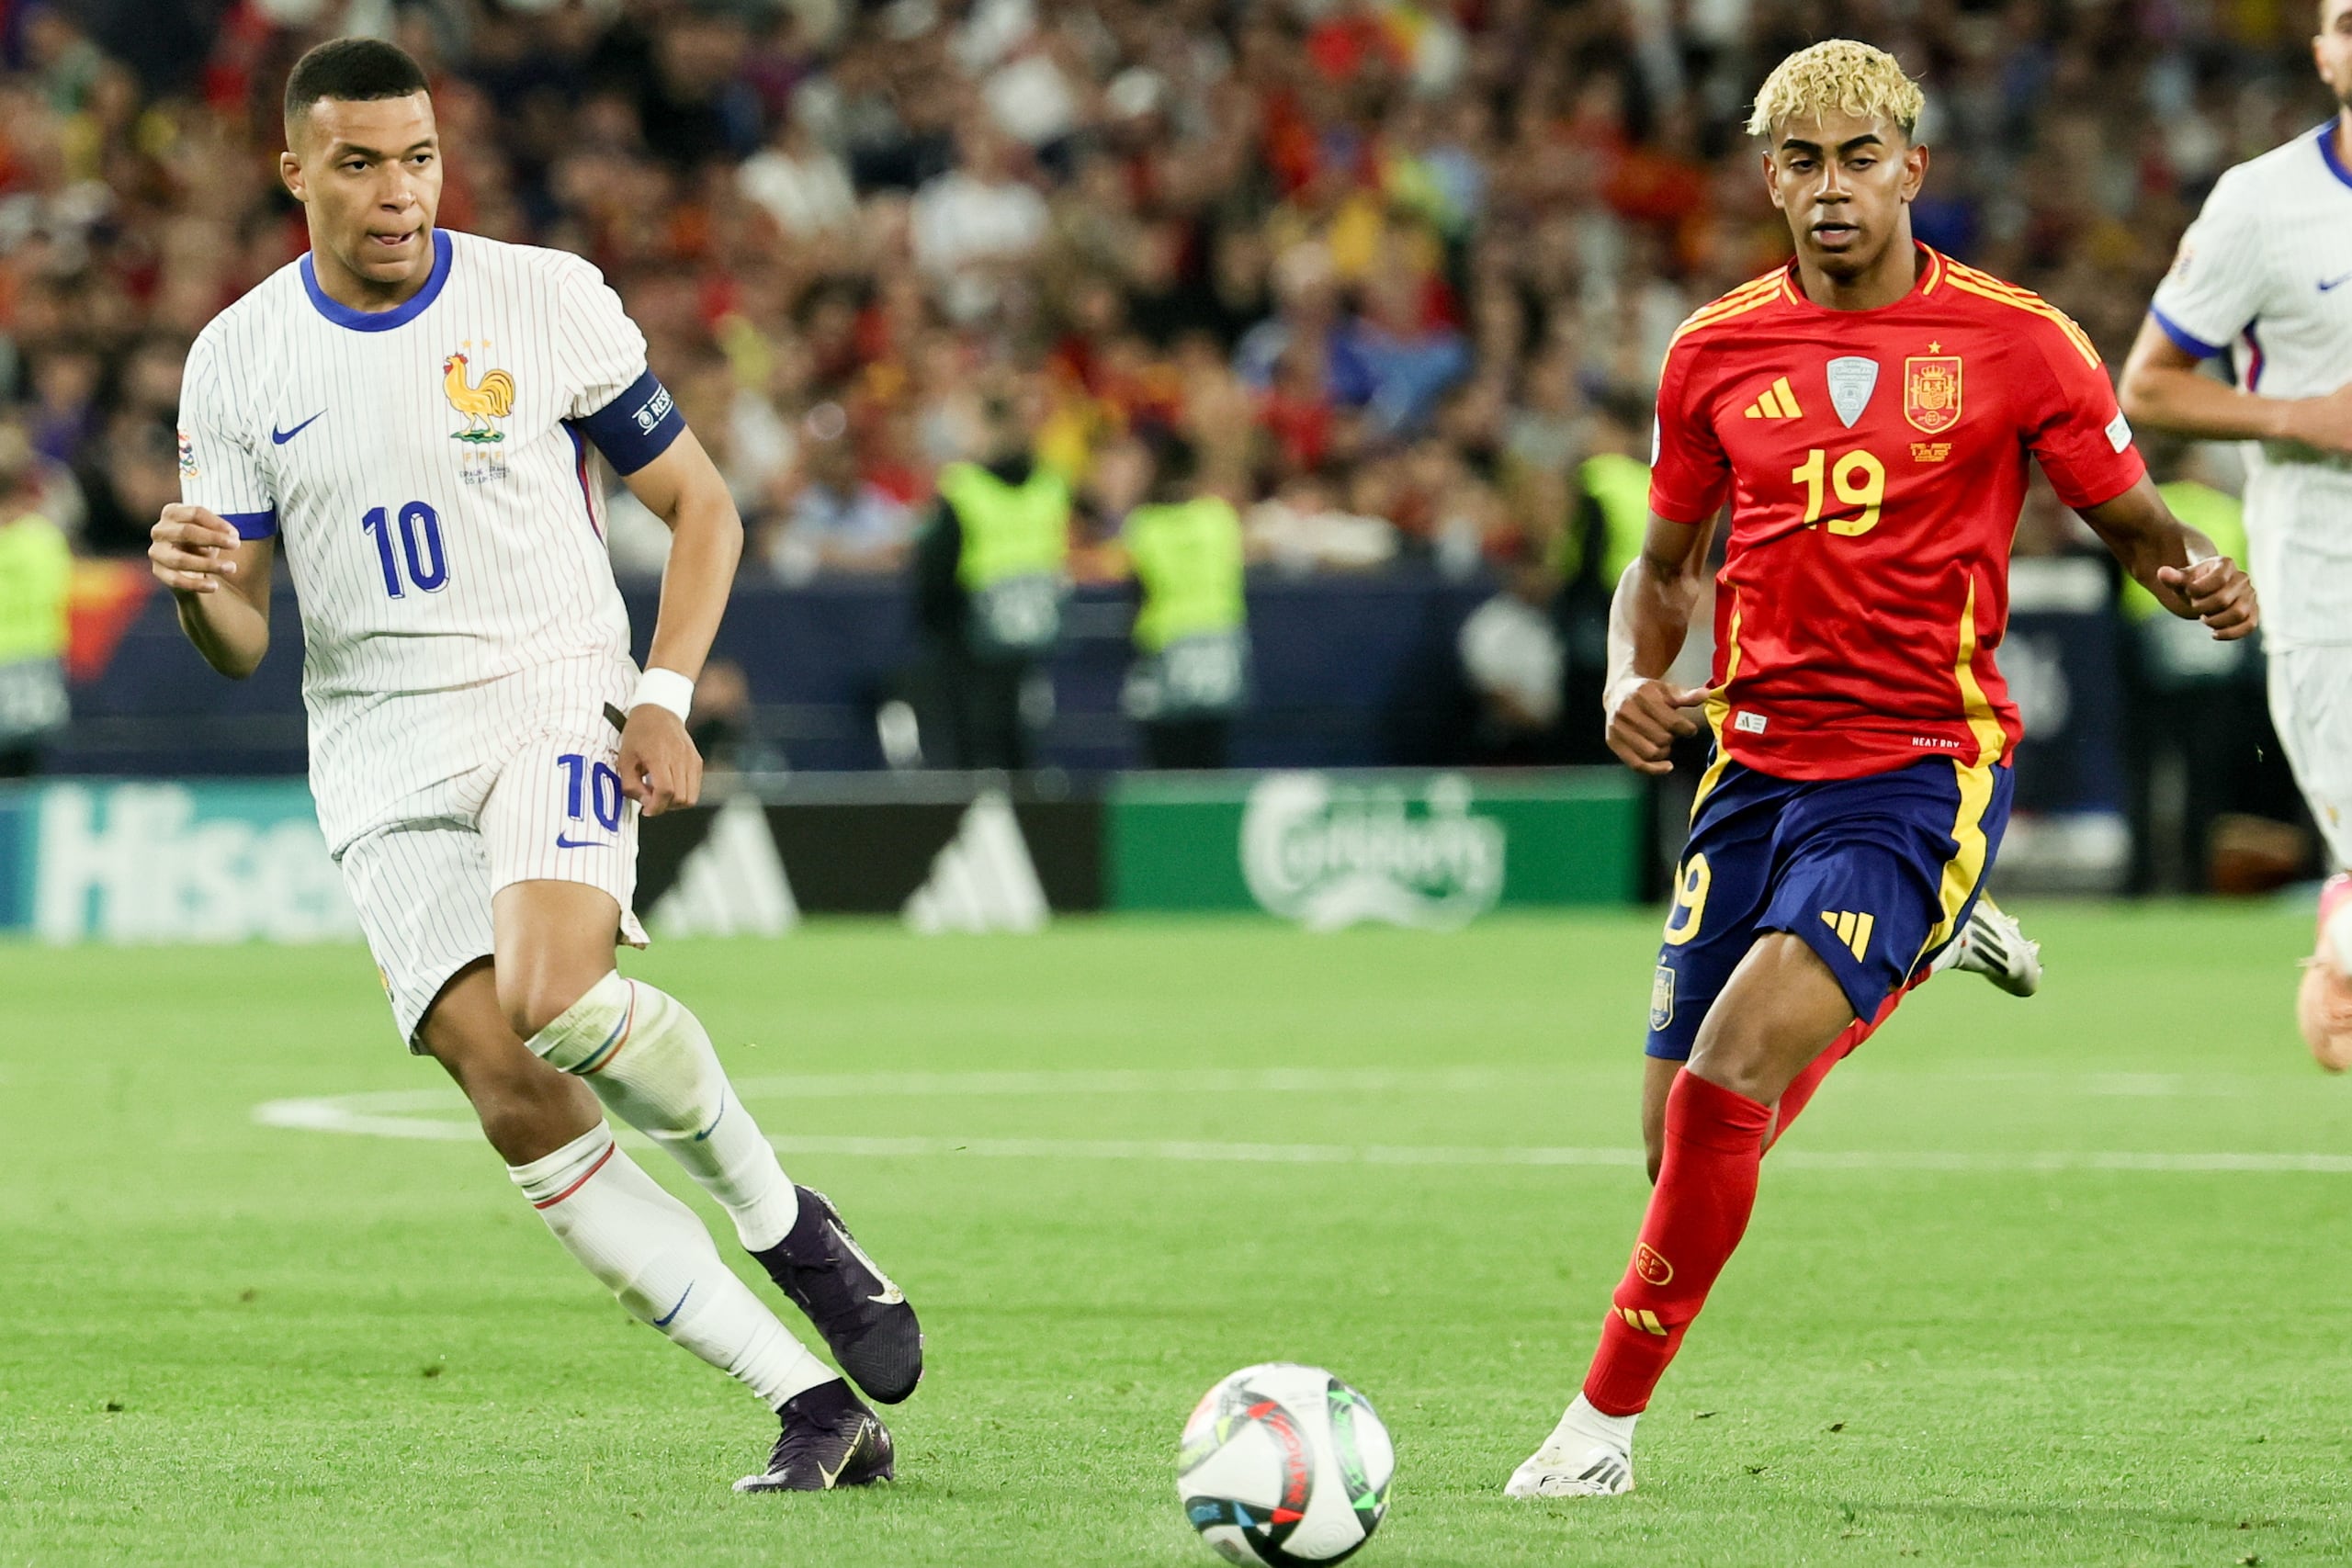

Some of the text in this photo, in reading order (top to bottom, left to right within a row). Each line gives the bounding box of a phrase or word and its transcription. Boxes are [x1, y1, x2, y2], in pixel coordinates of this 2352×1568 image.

[1792, 448, 1885, 537] 19
[362, 501, 450, 600] 10
[1912, 737, 1938, 747] HEAT
[557, 754, 623, 838] 10
